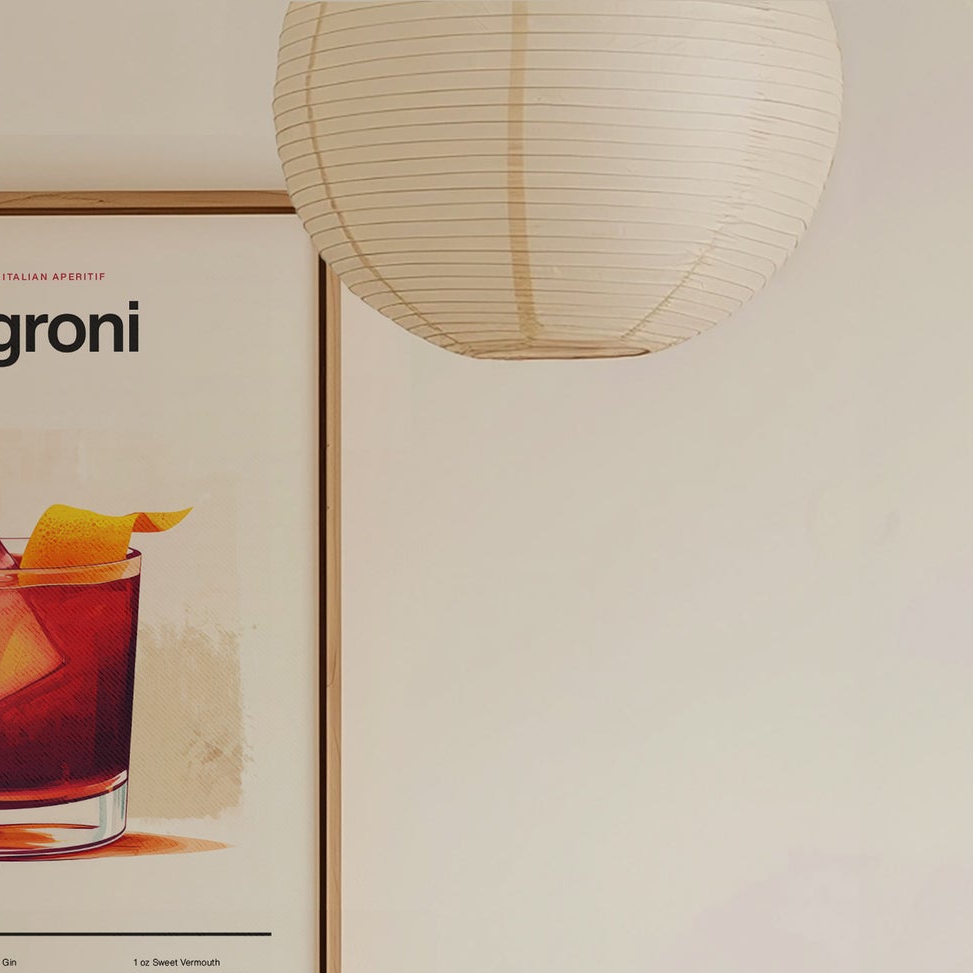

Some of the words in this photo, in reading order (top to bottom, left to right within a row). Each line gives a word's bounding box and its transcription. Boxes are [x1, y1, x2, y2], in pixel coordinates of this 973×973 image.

[3, 273, 47, 281] ITALIAN
[52, 273, 105, 281] APERITIF
[2, 958, 17, 967] Gin
[133, 958, 137, 967] 1
[140, 959, 150, 967] oz
[151, 958, 178, 967] Sweet
[180, 958, 220, 967] Vermouth
